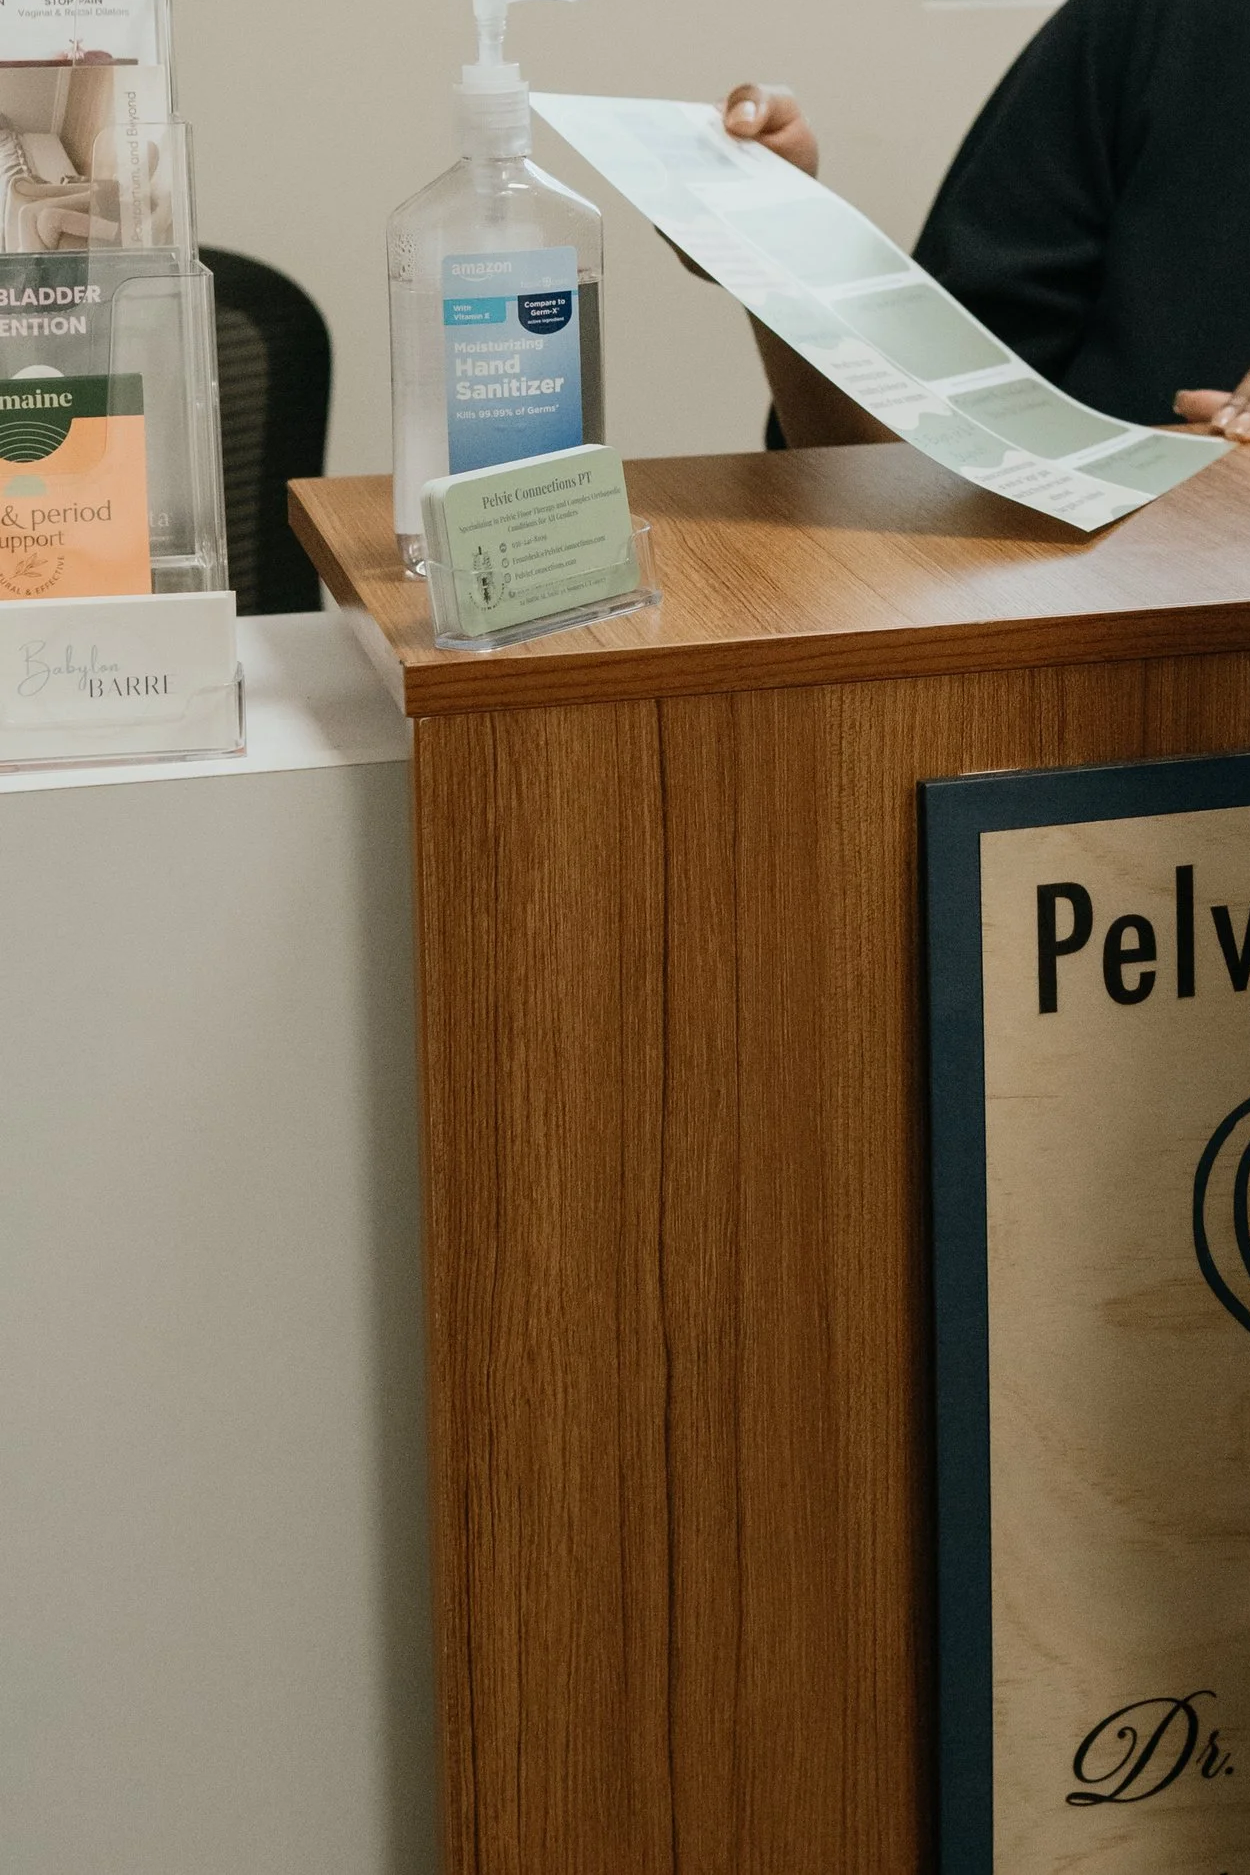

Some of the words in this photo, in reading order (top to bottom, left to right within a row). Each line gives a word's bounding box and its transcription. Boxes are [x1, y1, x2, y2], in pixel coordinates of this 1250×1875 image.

[18, 9, 53, 19] Vaginal
[451, 260, 513, 276] amazon
[453, 304, 472, 313] With
[524, 299, 556, 309] Compare
[557, 298, 566, 306] to
[454, 313, 483, 321] Vitamin
[454, 337, 544, 354] Moisturizing
[455, 354, 520, 377] Hand
[455, 376, 565, 401] Sanitizer
[456, 411, 476, 420] Kills
[478, 407, 514, 419] 99.99%
[515, 406, 526, 416] of
[482, 491, 513, 510] Pelvic
[515, 478, 577, 502] Connections
[578, 471, 592, 487] PT
[1, 505, 28, 530] &
[31, 499, 112, 531] period
[17, 639, 120, 697] Babylon
[89, 674, 177, 698] BARRE
[1065, 1689, 1236, 1808] Dr.
